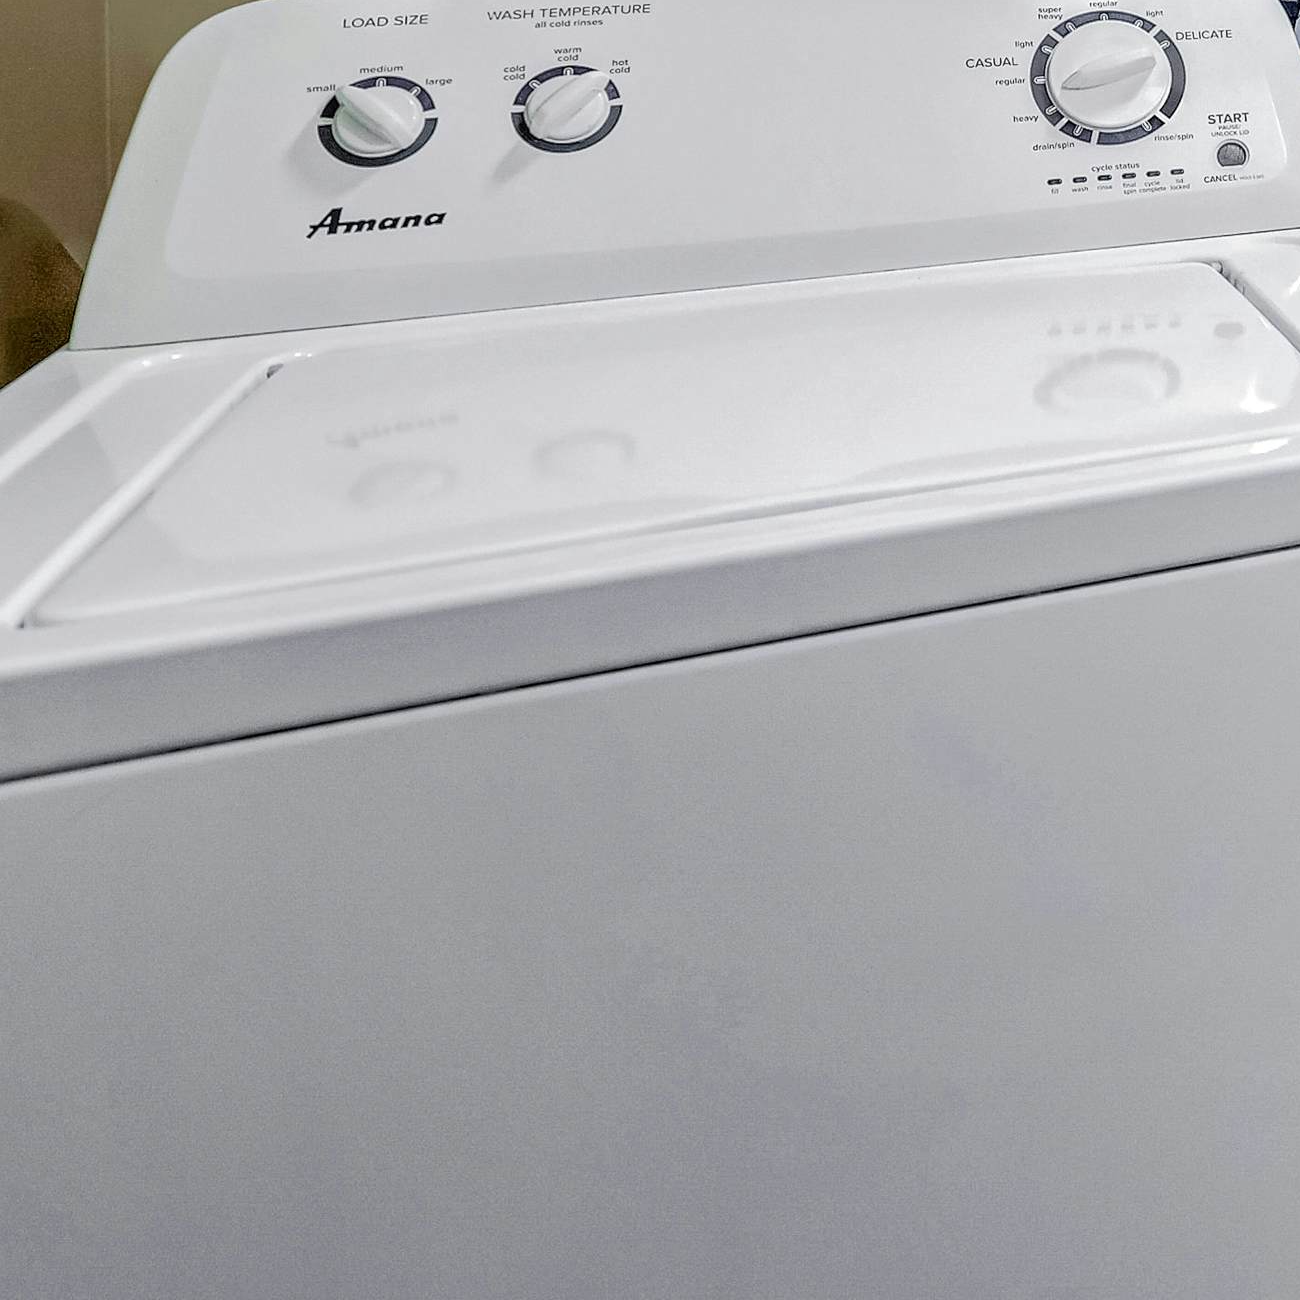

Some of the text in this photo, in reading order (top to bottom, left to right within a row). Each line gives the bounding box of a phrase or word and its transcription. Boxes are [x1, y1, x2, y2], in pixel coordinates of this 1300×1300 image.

[1089, 0, 1117, 9] regular
[487, 3, 651, 21] WASH TEMPERATURE
[1038, 6, 1062, 15] super
[1146, 9, 1164, 18] light
[343, 14, 429, 29] LOAD SIZE
[1038, 13, 1063, 21] heavy
[535, 18, 603, 29] all cold rinses
[1175, 29, 1233, 41] DELICATE
[1014, 39, 1034, 49] light
[553, 46, 582, 54] warm
[557, 54, 579, 62] cold
[965, 57, 1019, 68] CASUAL
[359, 64, 404, 74] medium
[503, 64, 526, 73] cold
[609, 65, 631, 75] cold
[503, 72, 526, 81] cold
[995, 77, 1026, 86] regular
[425, 77, 453, 87] large
[306, 84, 336, 93] small
[1013, 115, 1039, 124] heavy
[1208, 112, 1249, 124] START
[1154, 132, 1194, 142] rinse/spin
[1032, 141, 1075, 152] drain/spin
[1091, 162, 1140, 172] cycle status
[1204, 174, 1237, 183] CANCEL
[306, 207, 447, 239] Amana
